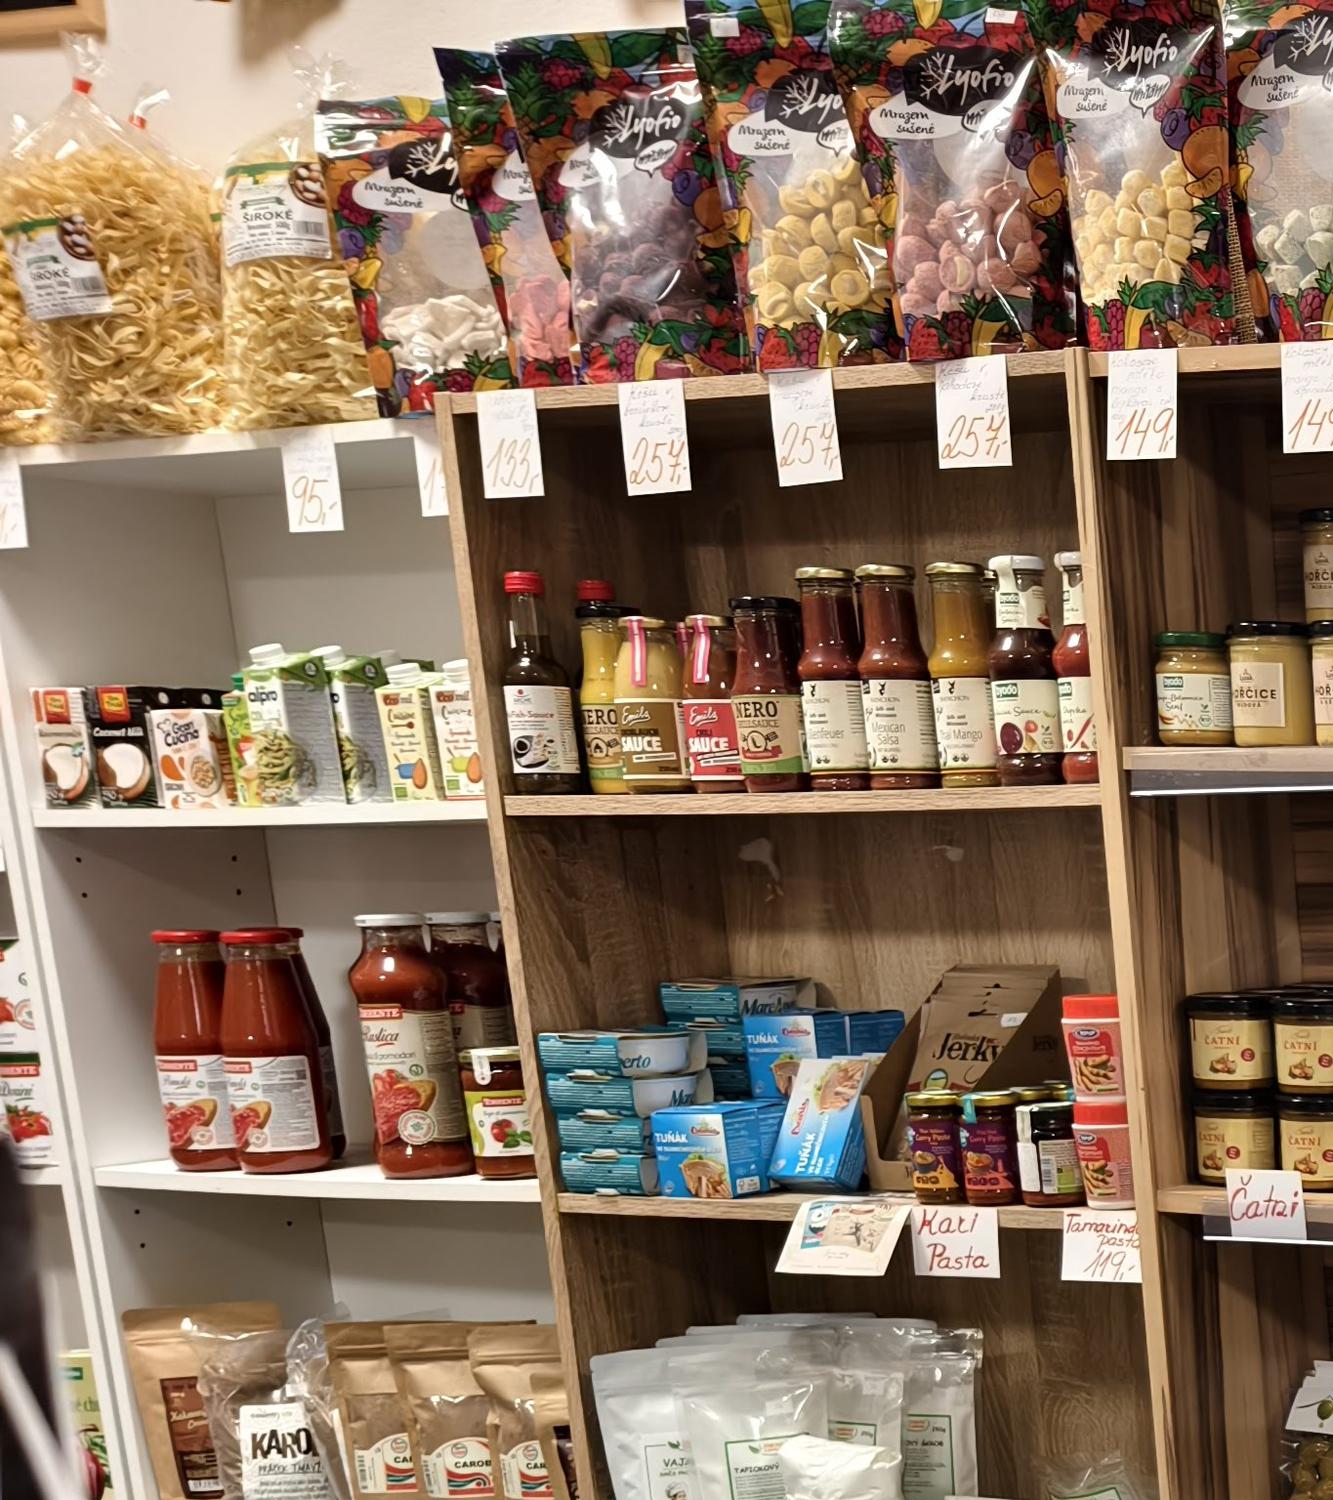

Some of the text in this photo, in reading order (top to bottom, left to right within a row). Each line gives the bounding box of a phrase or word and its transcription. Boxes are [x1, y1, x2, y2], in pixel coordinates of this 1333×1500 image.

[1117, 31, 1179, 71] Lyofio
[938, 55, 1017, 96] Lyofio
[241, 208, 294, 224] ŠIROKÉ
[248, 688, 277, 704] alpro
[622, 736, 662, 751] SAUCE
[953, 730, 983, 742] Mango
[655, 1130, 688, 1144] TUŇÁK
[251, 1426, 313, 1460] KARO
